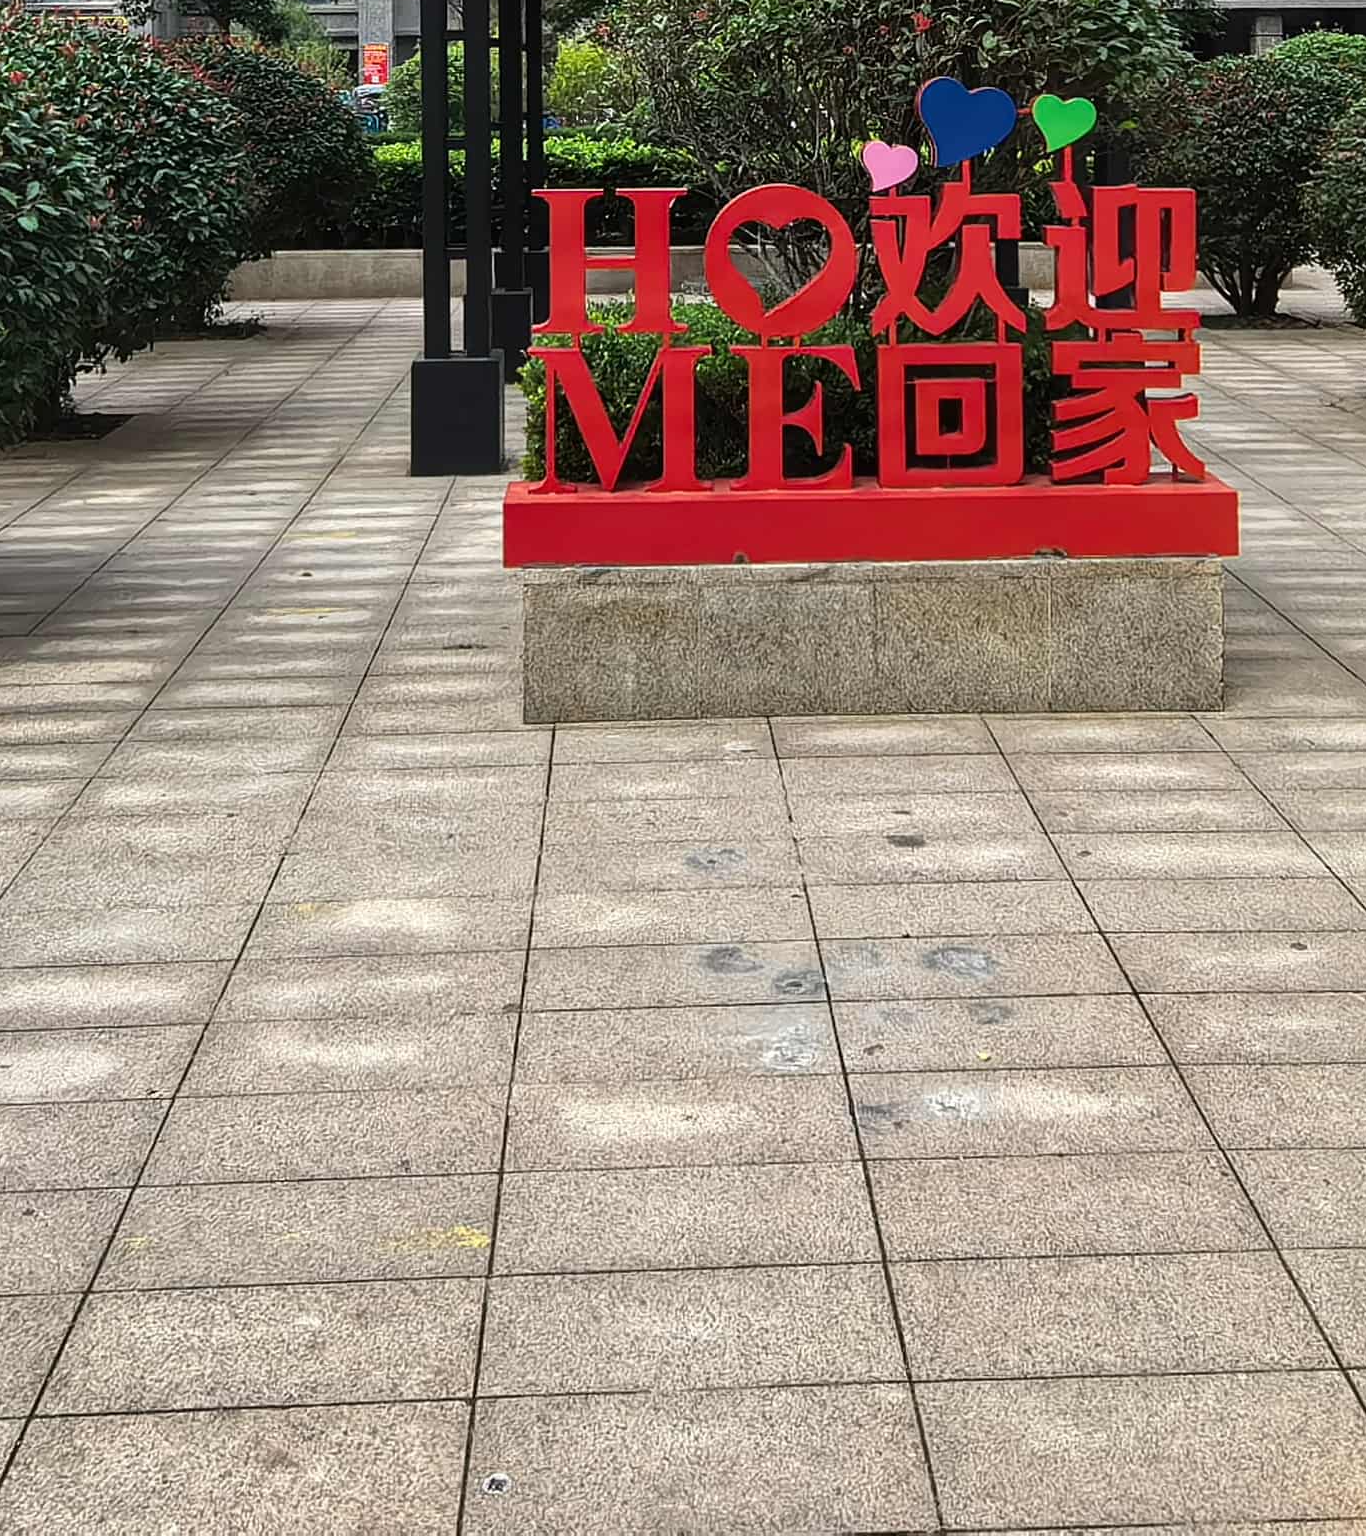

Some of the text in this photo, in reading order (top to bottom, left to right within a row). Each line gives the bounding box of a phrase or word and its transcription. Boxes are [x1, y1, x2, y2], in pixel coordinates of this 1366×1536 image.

[531, 183, 858, 337] HO
[871, 182, 1200, 334] 欢迎
[528, 345, 862, 494] ME
[877, 333, 1206, 486] 回家
